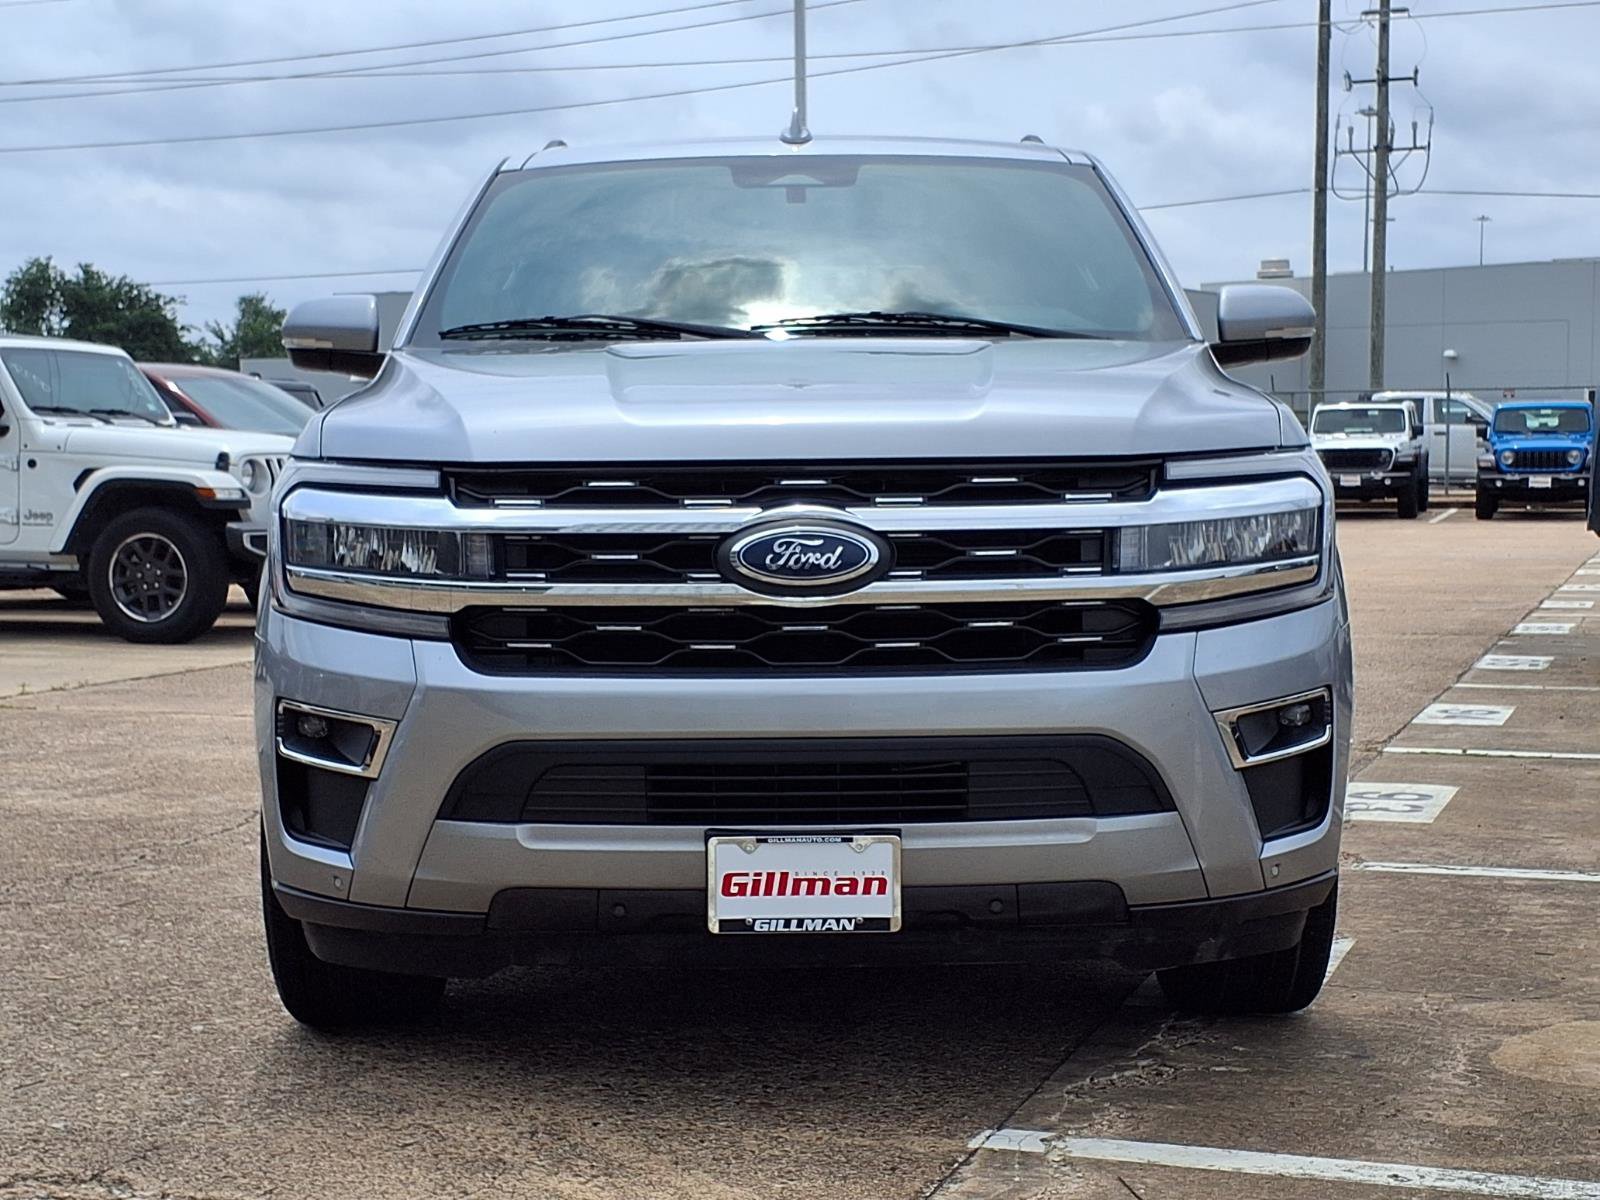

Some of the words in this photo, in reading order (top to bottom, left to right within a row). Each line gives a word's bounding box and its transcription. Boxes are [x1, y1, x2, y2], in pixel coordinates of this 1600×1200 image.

[24, 509, 54, 523] Jeep
[766, 538, 842, 570] Ford
[721, 871, 888, 897] Gillman
[754, 919, 855, 931] GILLMAN
